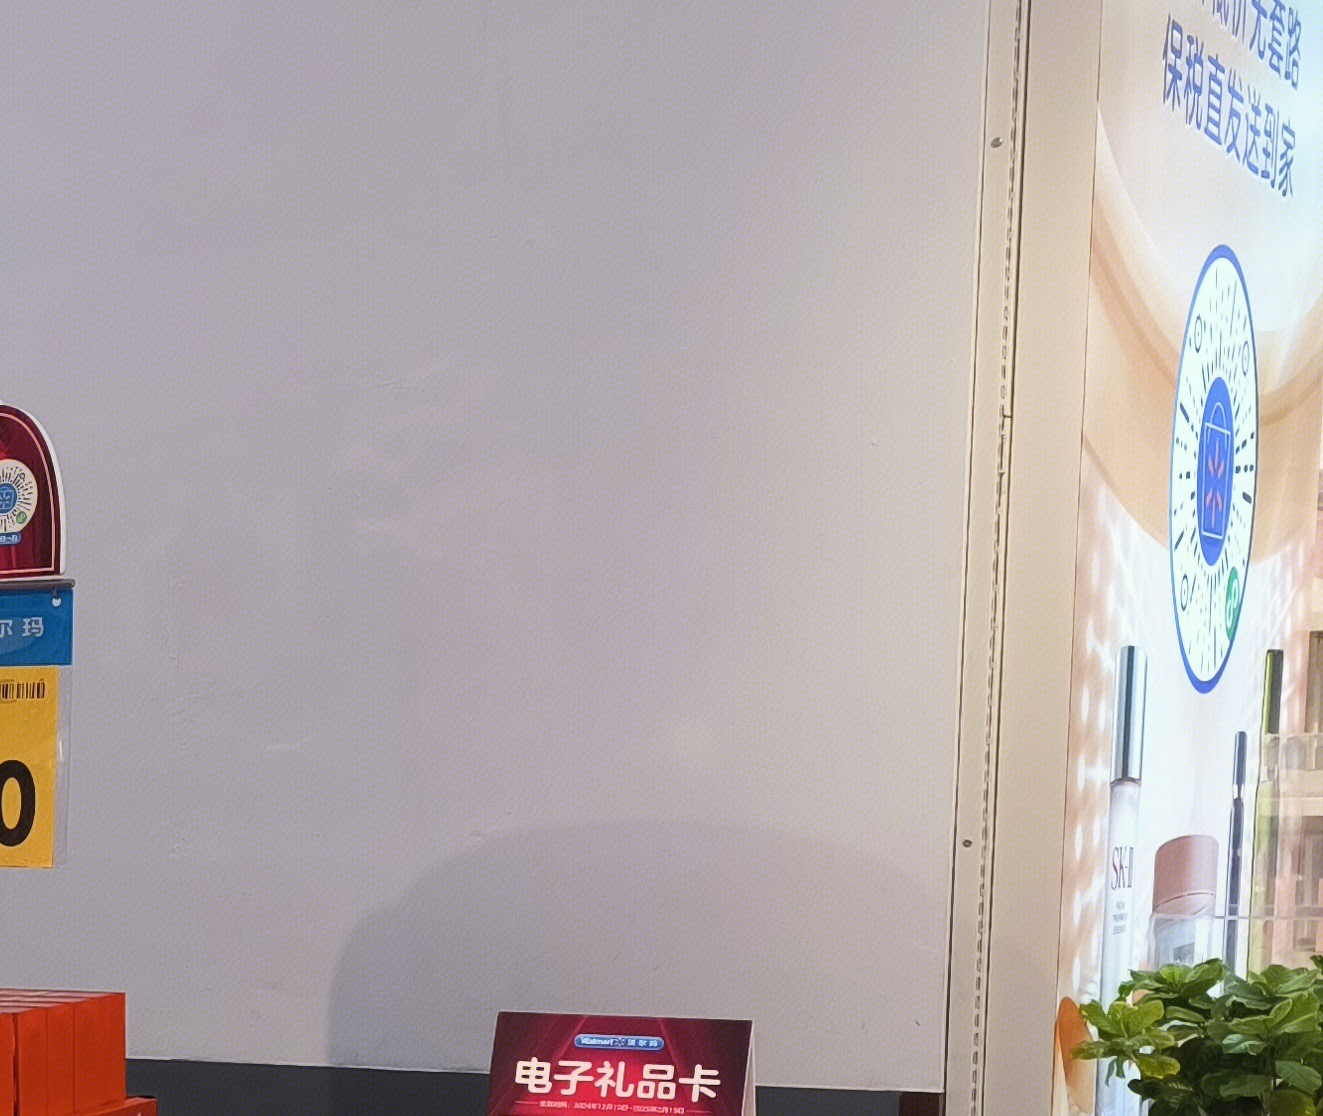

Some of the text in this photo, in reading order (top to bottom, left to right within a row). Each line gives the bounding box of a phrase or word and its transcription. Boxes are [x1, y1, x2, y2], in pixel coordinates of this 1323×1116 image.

[1202, 0, 1301, 90] 无套路
[1163, 11, 1295, 197] 保税直发送到家
[515, 1057, 721, 1103] 电子礼品卡
